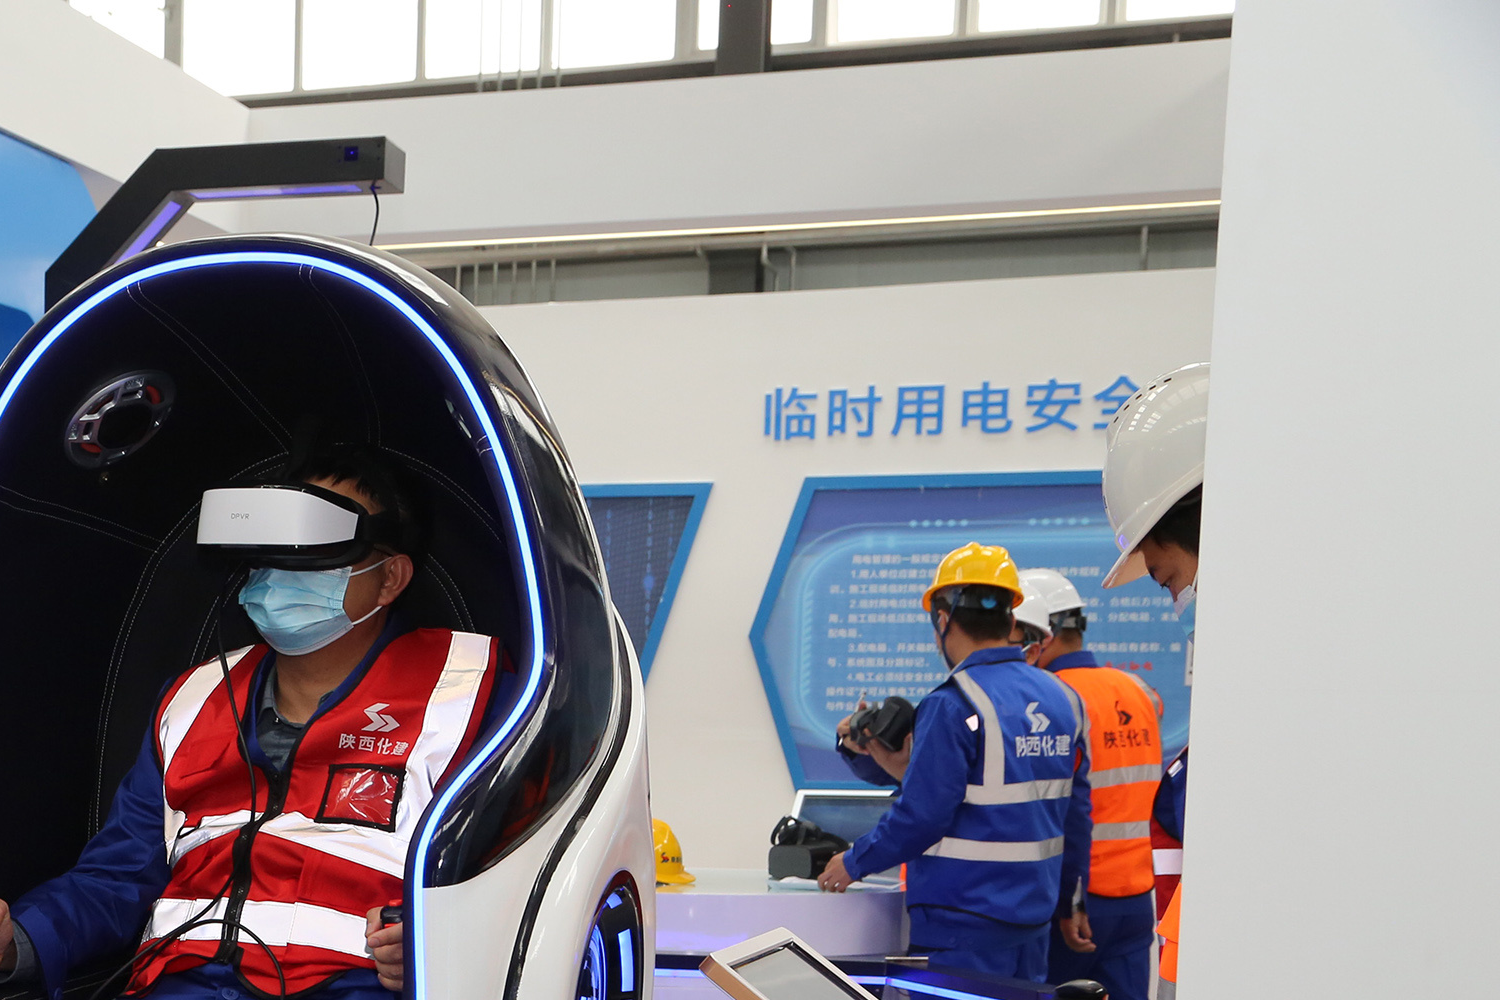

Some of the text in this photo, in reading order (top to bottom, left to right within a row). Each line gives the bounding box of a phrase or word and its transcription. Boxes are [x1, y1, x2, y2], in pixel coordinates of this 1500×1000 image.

[763, 375, 1140, 441] 临时用电安全
[230, 512, 250, 520] DPVR
[338, 733, 409, 756] 陕西化建
[1015, 733, 1071, 758] 陕西化建
